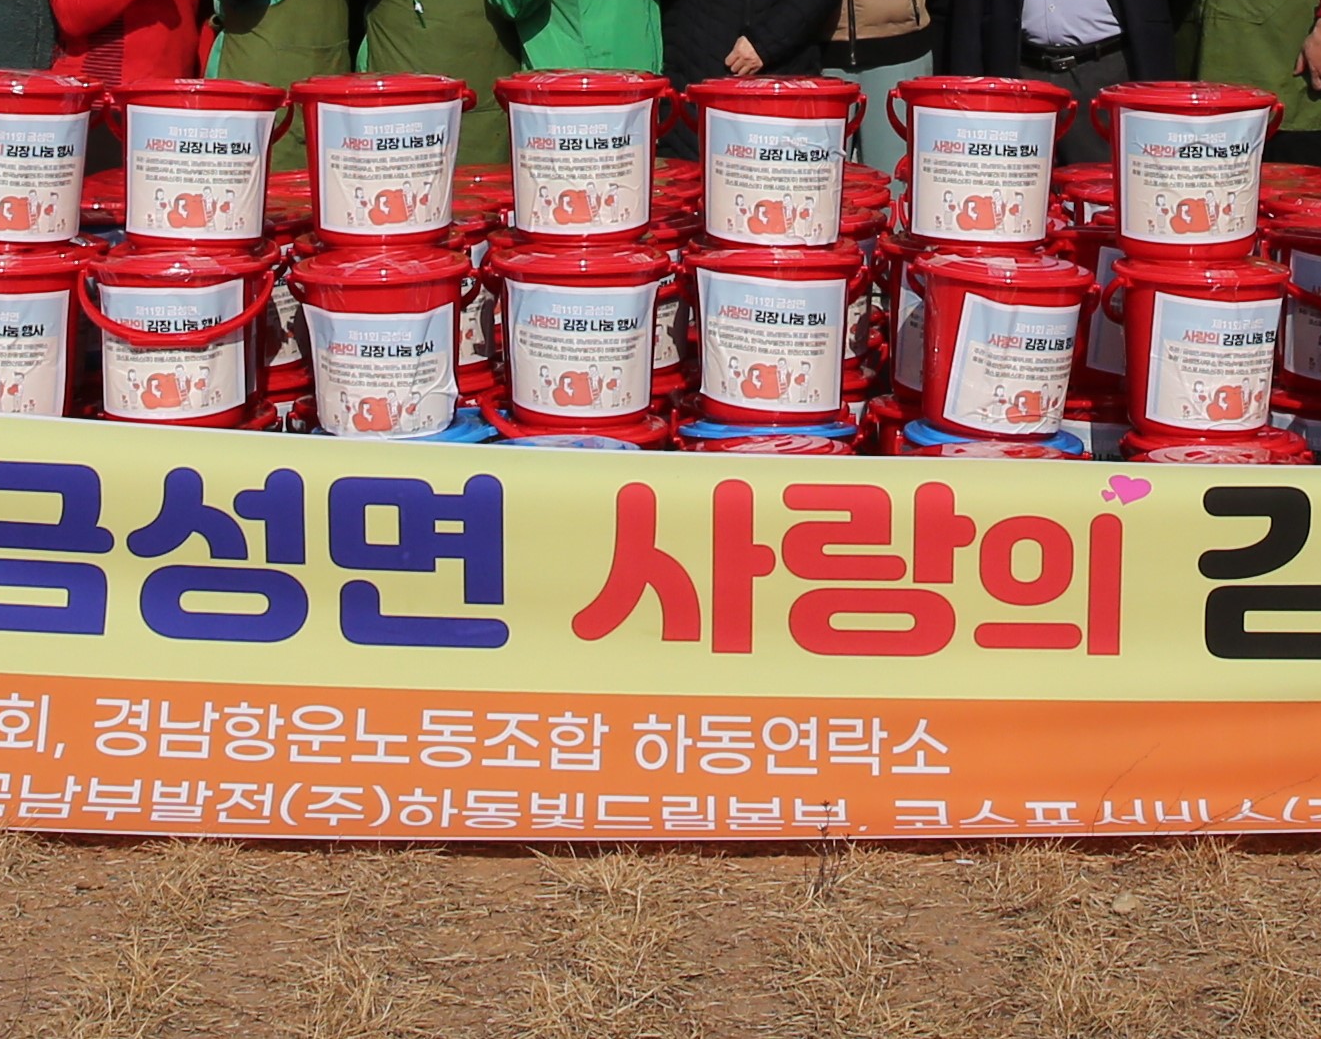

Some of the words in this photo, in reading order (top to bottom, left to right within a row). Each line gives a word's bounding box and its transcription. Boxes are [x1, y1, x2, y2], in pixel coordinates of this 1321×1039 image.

[6, 145, 30, 158] 김장
[32, 145, 55, 159] 나눔
[57, 144, 75, 158] 행사
[145, 138, 177, 152] 사랑의
[179, 141, 203, 154] 김장
[205, 141, 229, 155] 나눔
[231, 142, 252, 156] 행사
[341, 136, 374, 150] 사랑의
[377, 137, 399, 151] 김장
[402, 136, 424, 150] 나눔
[526, 137, 556, 150] 사랑의
[559, 137, 582, 151] 김장
[585, 137, 609, 150] 나눔
[612, 135, 631, 149] 행사
[933, 140, 966, 154] 사랑의
[968, 143, 992, 157] 김장
[995, 144, 1018, 158] 나눔
[1020, 144, 1039, 158] 행사
[1143, 143, 1177, 158] 사랑의
[1180, 145, 1203, 159] 김장
[1206, 145, 1228, 159] 나눔
[1230, 143, 1250, 157] 행사
[725, 145, 757, 160] 사랑의
[760, 148, 783, 162] 김장
[786, 149, 808, 162] 나눔
[528, 314, 560, 328] 사랑의
[563, 318, 588, 332] 김장
[590, 319, 614, 332] 나눔
[617, 316, 637, 330] 행사
[718, 306, 753, 322] 사랑의
[755, 309, 779, 324] 김장
[781, 311, 805, 325] 나눔
[807, 312, 827, 327] 행사
[22, 323, 45, 338] 행사
[1183, 331, 1220, 345] 사랑의
[1223, 332, 1245, 346] 김장
[328, 342, 356, 356] 사랑의
[360, 344, 385, 359] 김장
[388, 344, 412, 358] 나눔
[988, 335, 1023, 349] 사랑의
[1025, 337, 1047, 351] 김장
[570, 477, 1124, 658] 사랑의
[93, 696, 610, 772] 경남항운노동조합
[632, 712, 951, 777] 하동연락소
